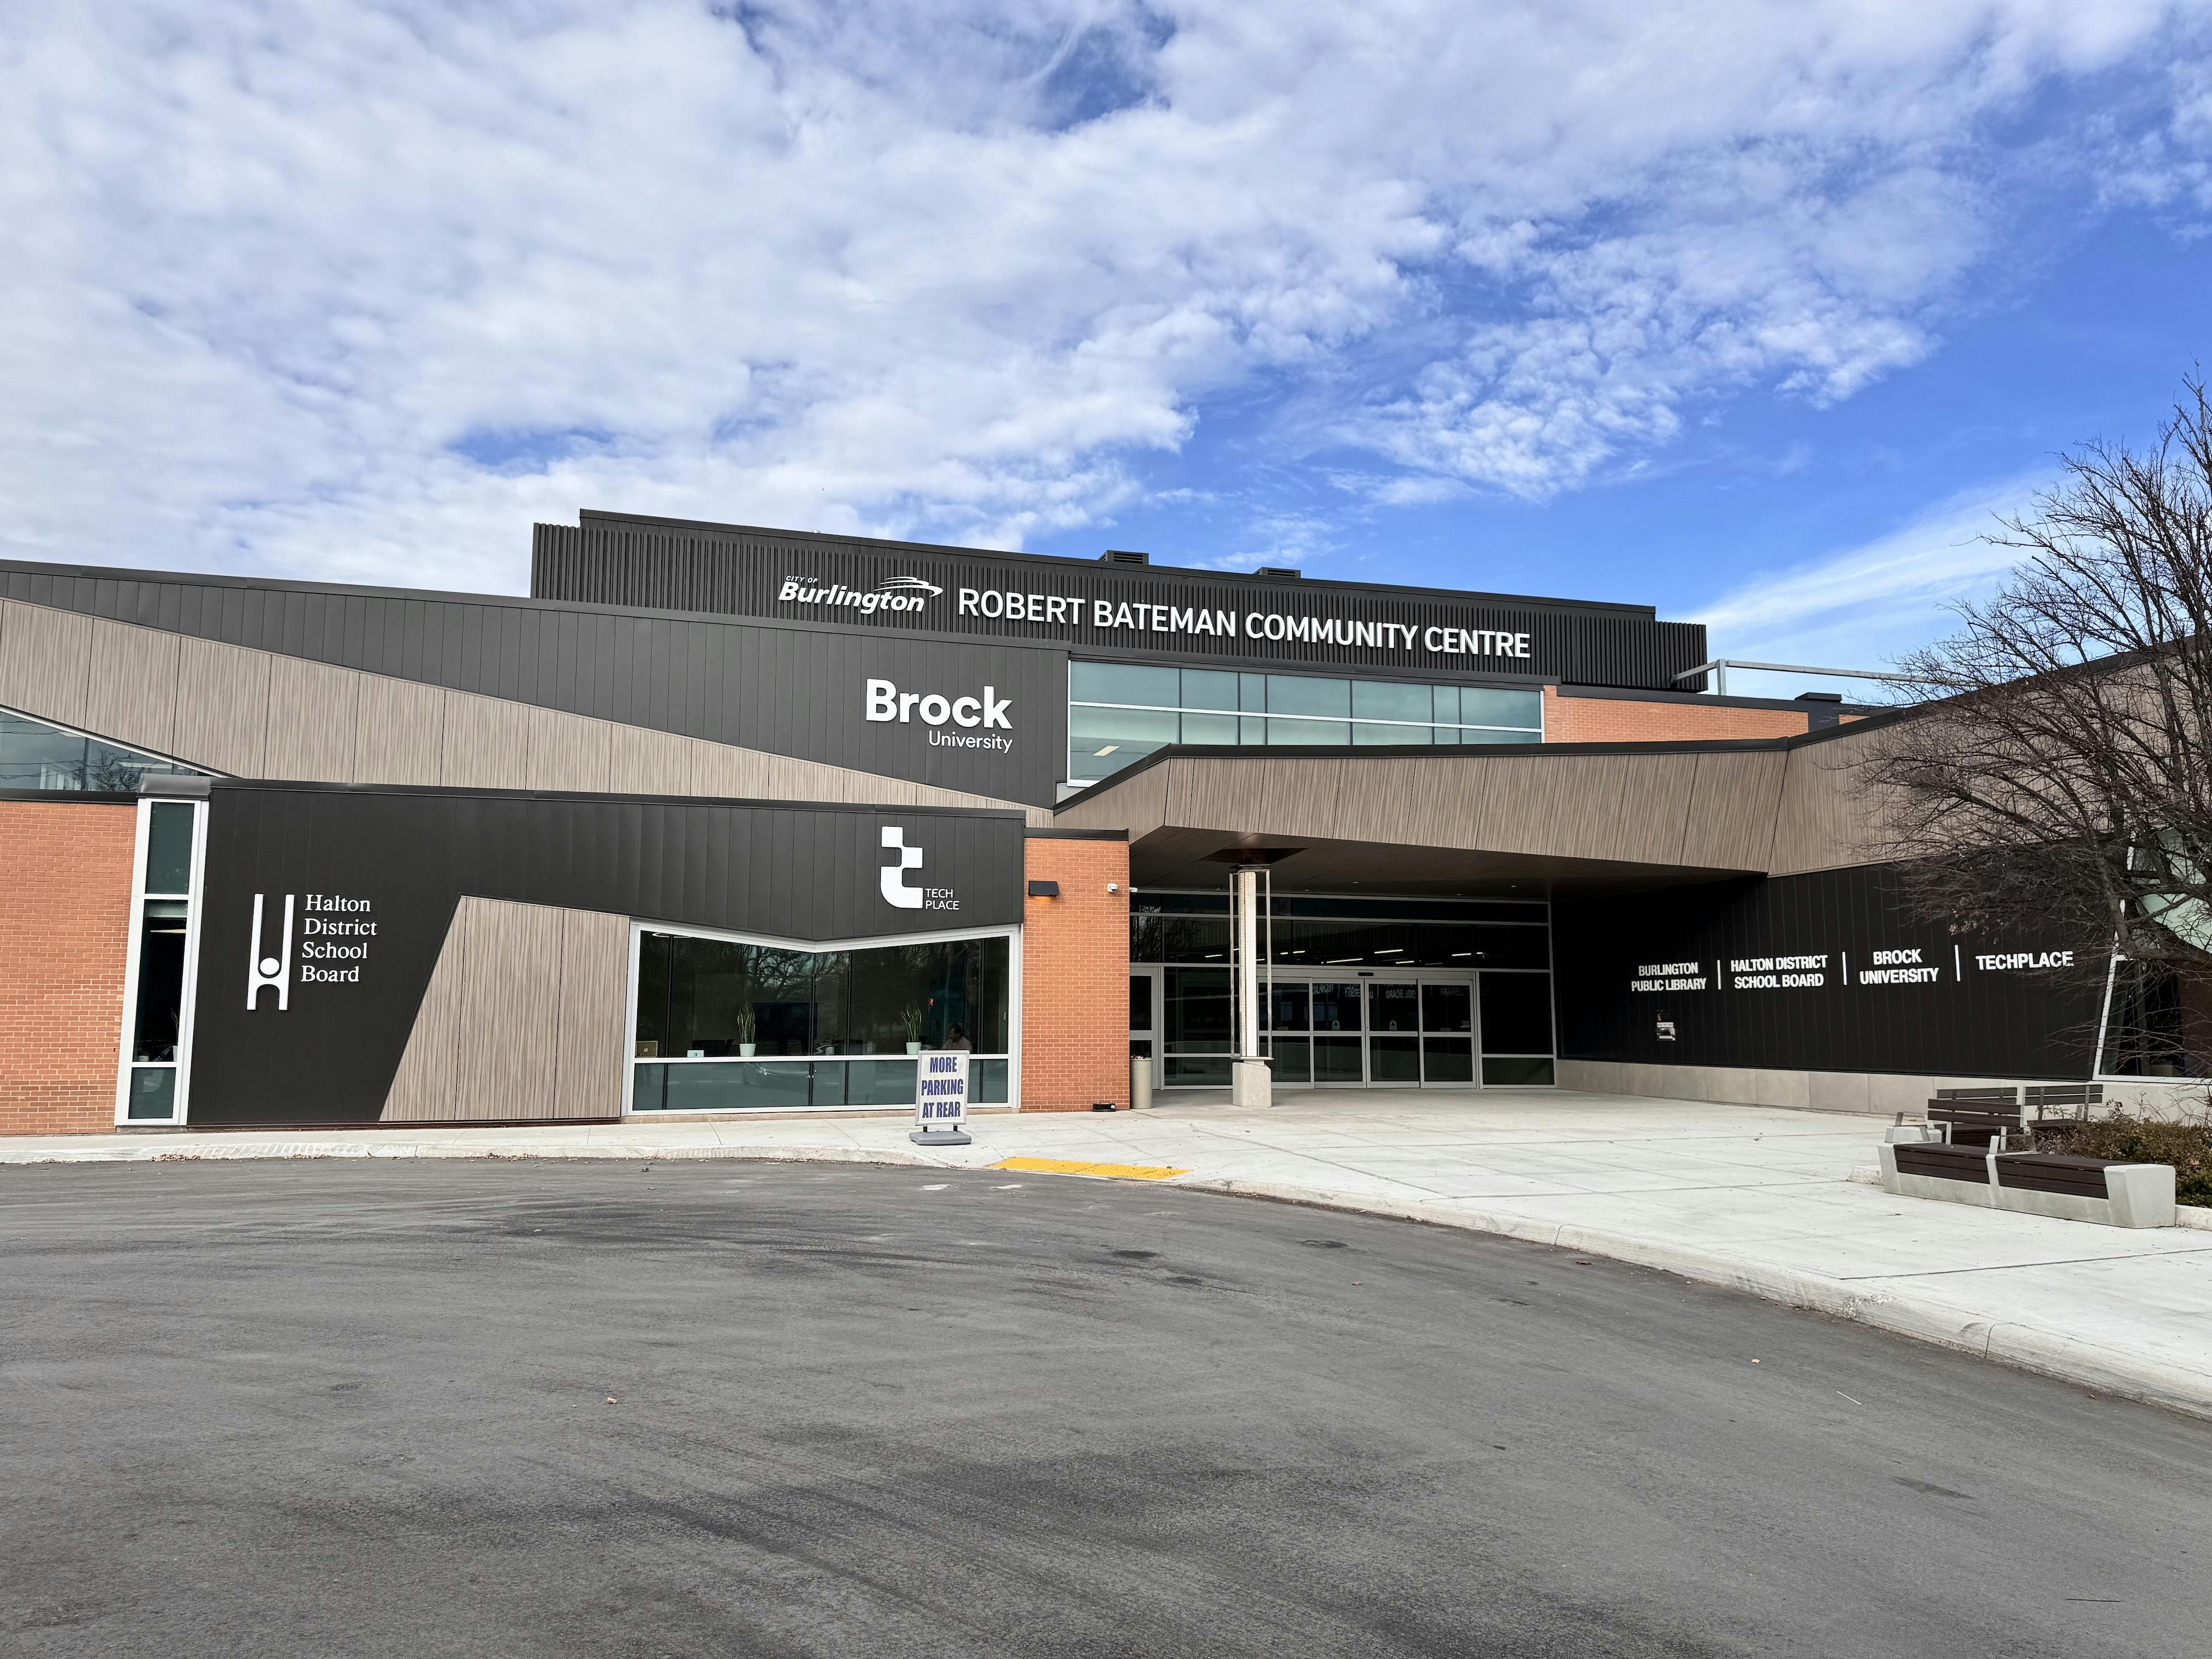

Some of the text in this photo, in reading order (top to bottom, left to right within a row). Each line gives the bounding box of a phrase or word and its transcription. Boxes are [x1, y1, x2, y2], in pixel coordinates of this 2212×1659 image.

[778, 581, 925, 614] Burlington
[959, 588, 1531, 658] ROBERT BATEMAN COMMUNITY CENTRE
[866, 679, 1013, 729] Brock
[929, 730, 1013, 753] University
[925, 888, 953, 899] TECH
[305, 894, 370, 912] Halton
[925, 900, 960, 910] PLACE
[304, 918, 377, 936] District
[302, 941, 368, 959] School
[1873, 948, 1923, 965] BROCK
[1638, 962, 1699, 976] BURLINGTON
[1730, 955, 1828, 972] HALTON DISTRICT
[1975, 950, 2074, 971] TECHPLACE
[300, 965, 359, 982] Board
[1734, 973, 1824, 989] SCHOOL BOARD
[1859, 967, 1940, 985] UNIVERSITY
[1631, 978, 1707, 992] PUBLIC LIBRARY
[930, 1056, 957, 1073] MORE
[921, 1078, 964, 1096] PARKING
[922, 1101, 961, 1119] AT REAR
